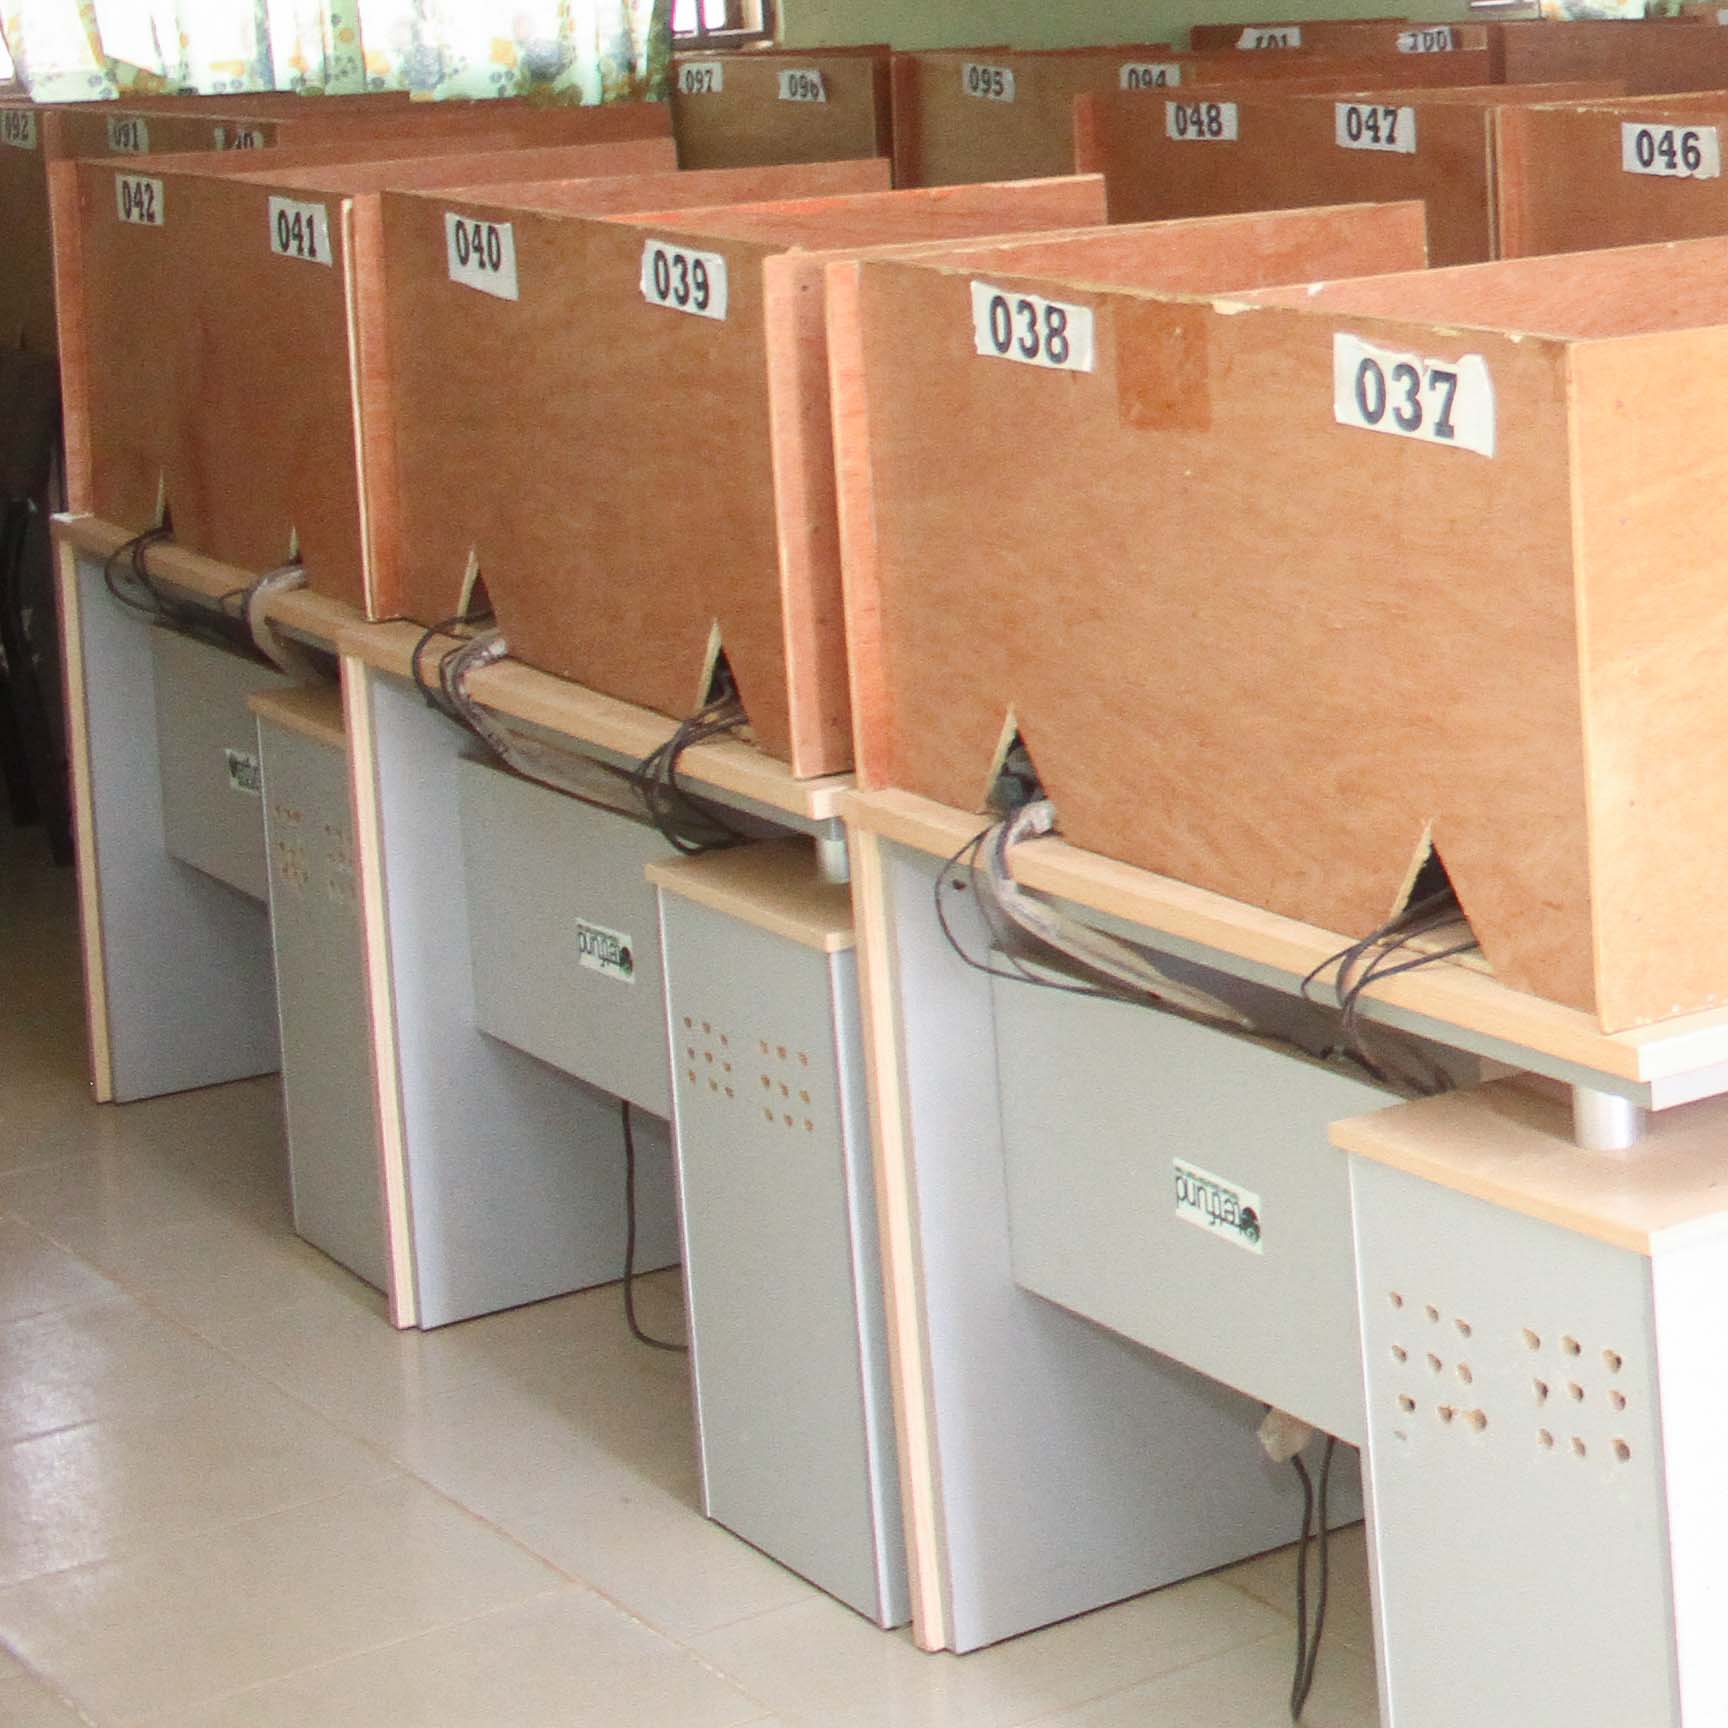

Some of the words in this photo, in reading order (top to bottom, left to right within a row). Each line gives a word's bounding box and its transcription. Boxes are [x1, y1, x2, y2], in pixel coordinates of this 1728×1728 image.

[684, 69, 713, 91] 097
[788, 73, 820, 99] 096
[968, 66, 1005, 97] 095
[1175, 103, 1223, 139] 048
[1346, 106, 1398, 145] 047
[1634, 128, 1702, 172] 046
[122, 179, 156, 223] 042
[277, 208, 319, 258] 041
[455, 219, 502, 273] 040
[653, 247, 710, 312] 039
[988, 294, 1070, 366] 038
[1354, 357, 1459, 440] 037
